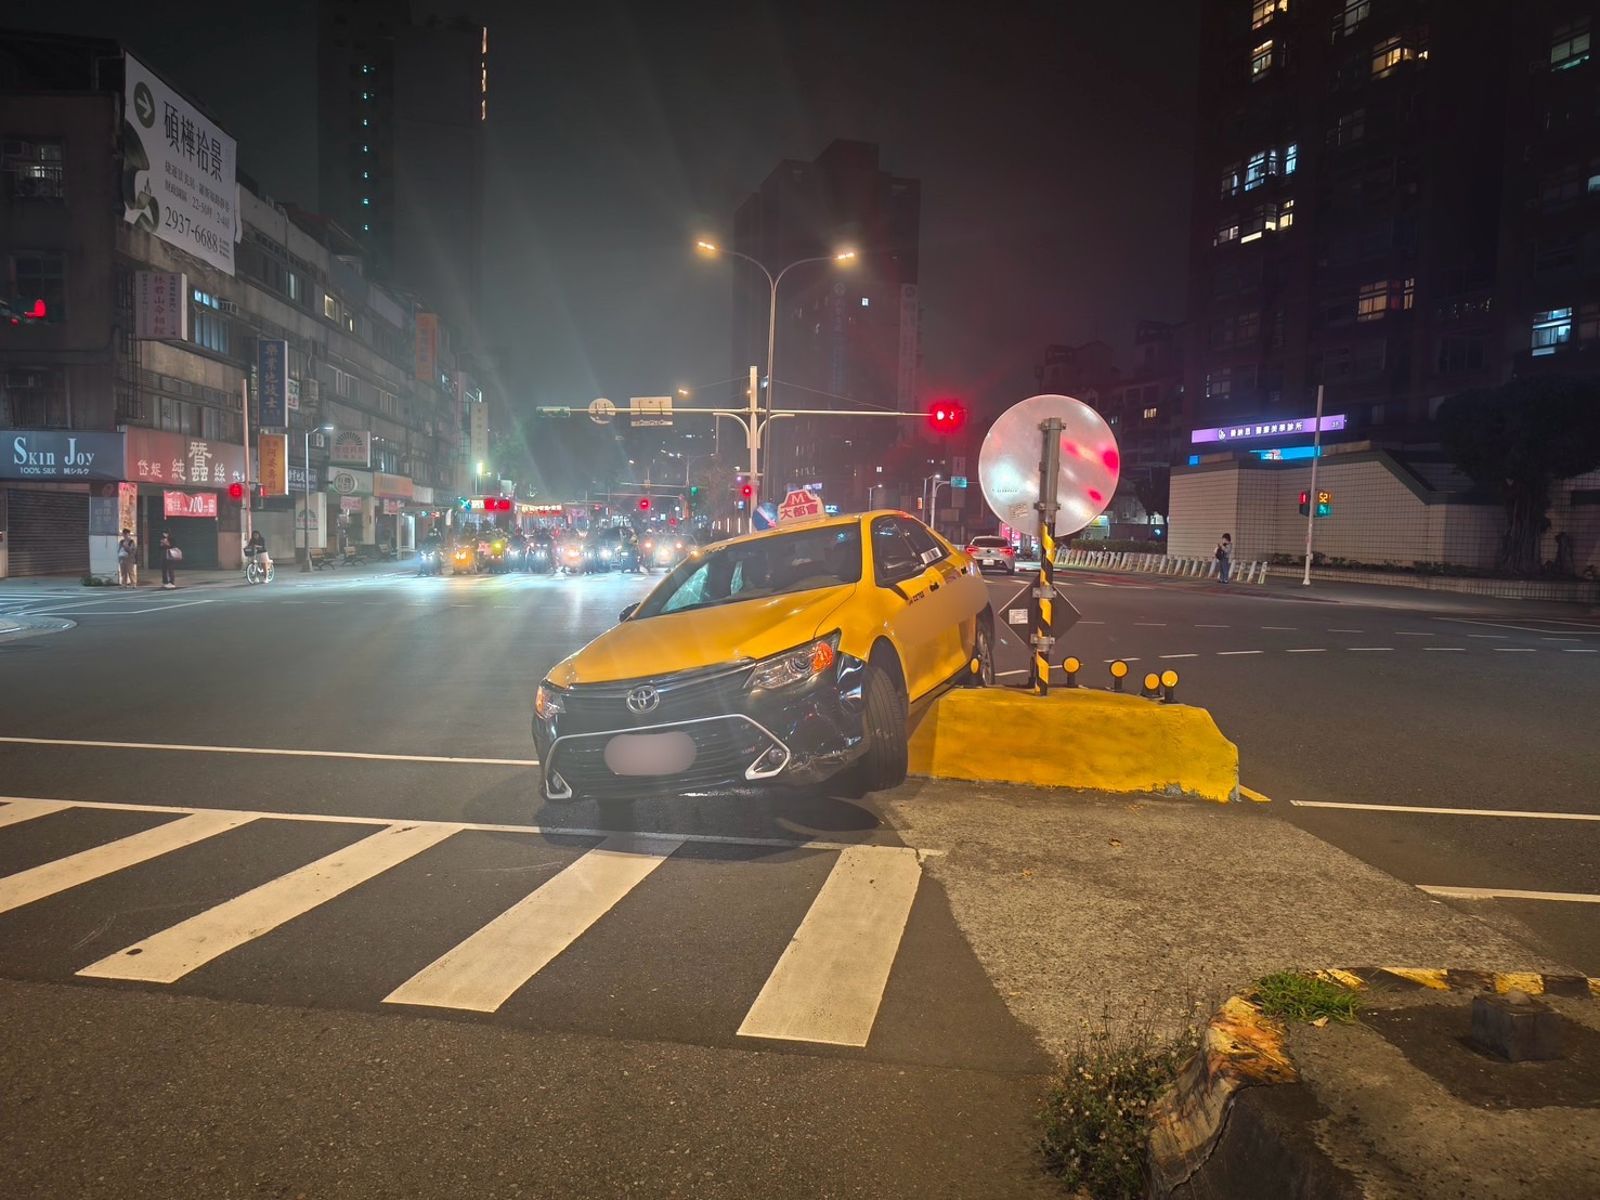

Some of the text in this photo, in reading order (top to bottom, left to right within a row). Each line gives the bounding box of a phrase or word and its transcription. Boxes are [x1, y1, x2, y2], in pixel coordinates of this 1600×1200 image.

[164, 101, 222, 182] 碩樺拾景
[165, 206, 218, 253] 2937-6688
[20, 467, 41, 475] 100%
[1319, 492, 1329, 503] 52
